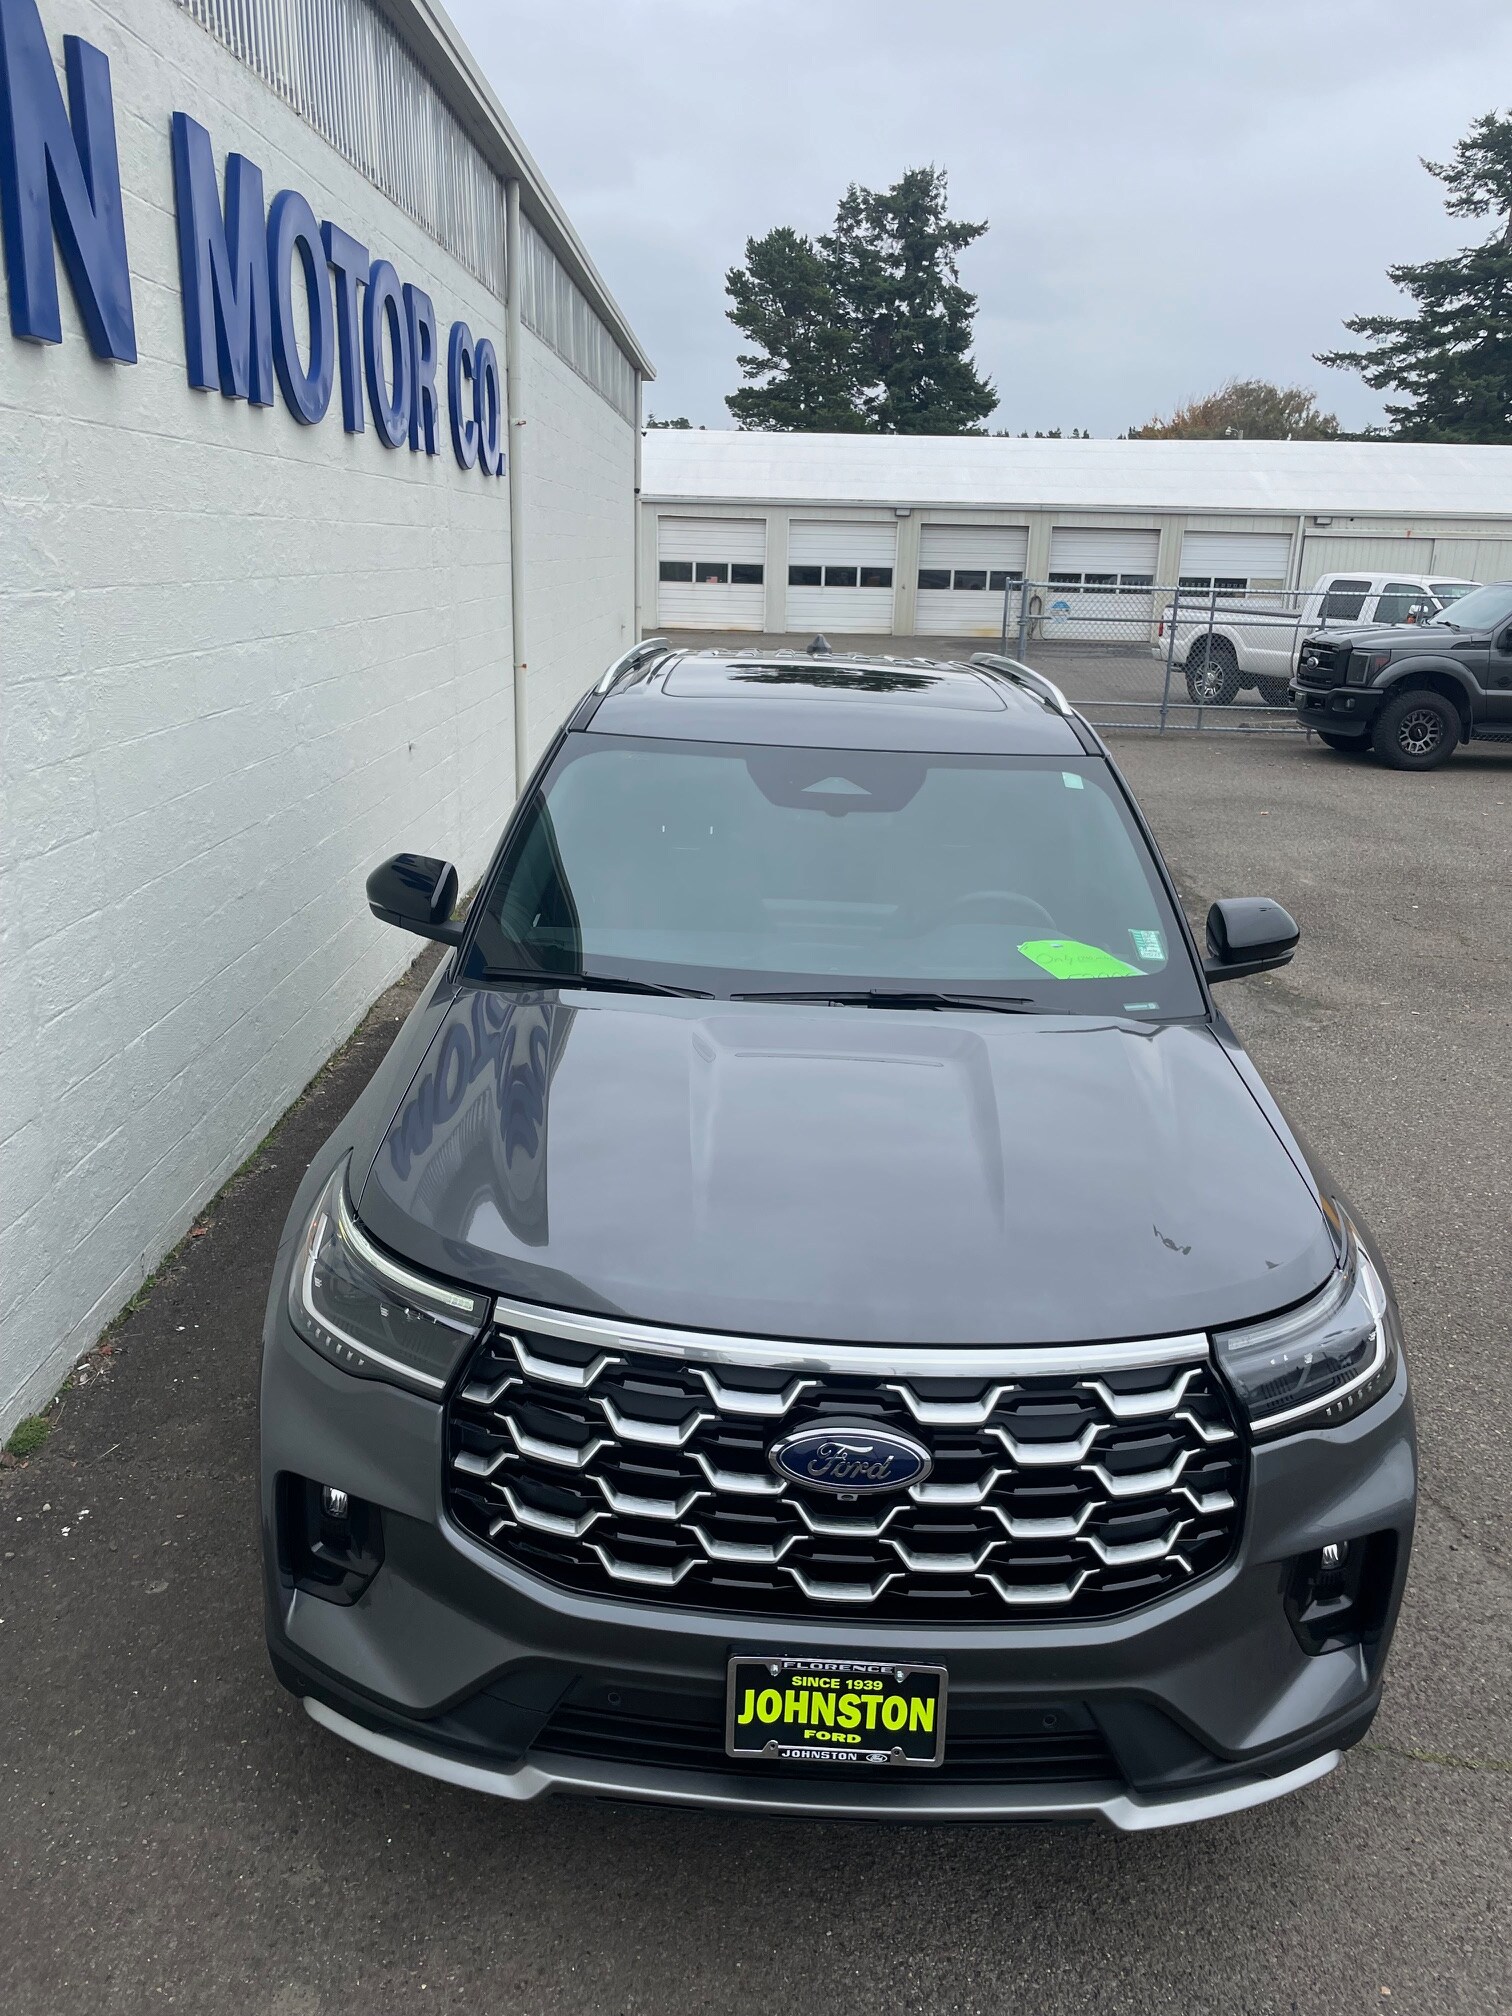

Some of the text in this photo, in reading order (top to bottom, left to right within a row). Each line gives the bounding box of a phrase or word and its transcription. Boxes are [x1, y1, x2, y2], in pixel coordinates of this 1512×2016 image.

[172, 111, 440, 456] MOTOR
[448, 320, 506, 476] CO.
[807, 1441, 895, 1480] Ford
[783, 1661, 894, 1674] FLORENCE
[791, 1676, 884, 1691] SINCE 1939
[737, 1688, 935, 1732] JOHNSTON
[803, 1729, 862, 1744] FORD
[781, 1749, 858, 1761] JOHNSTON
